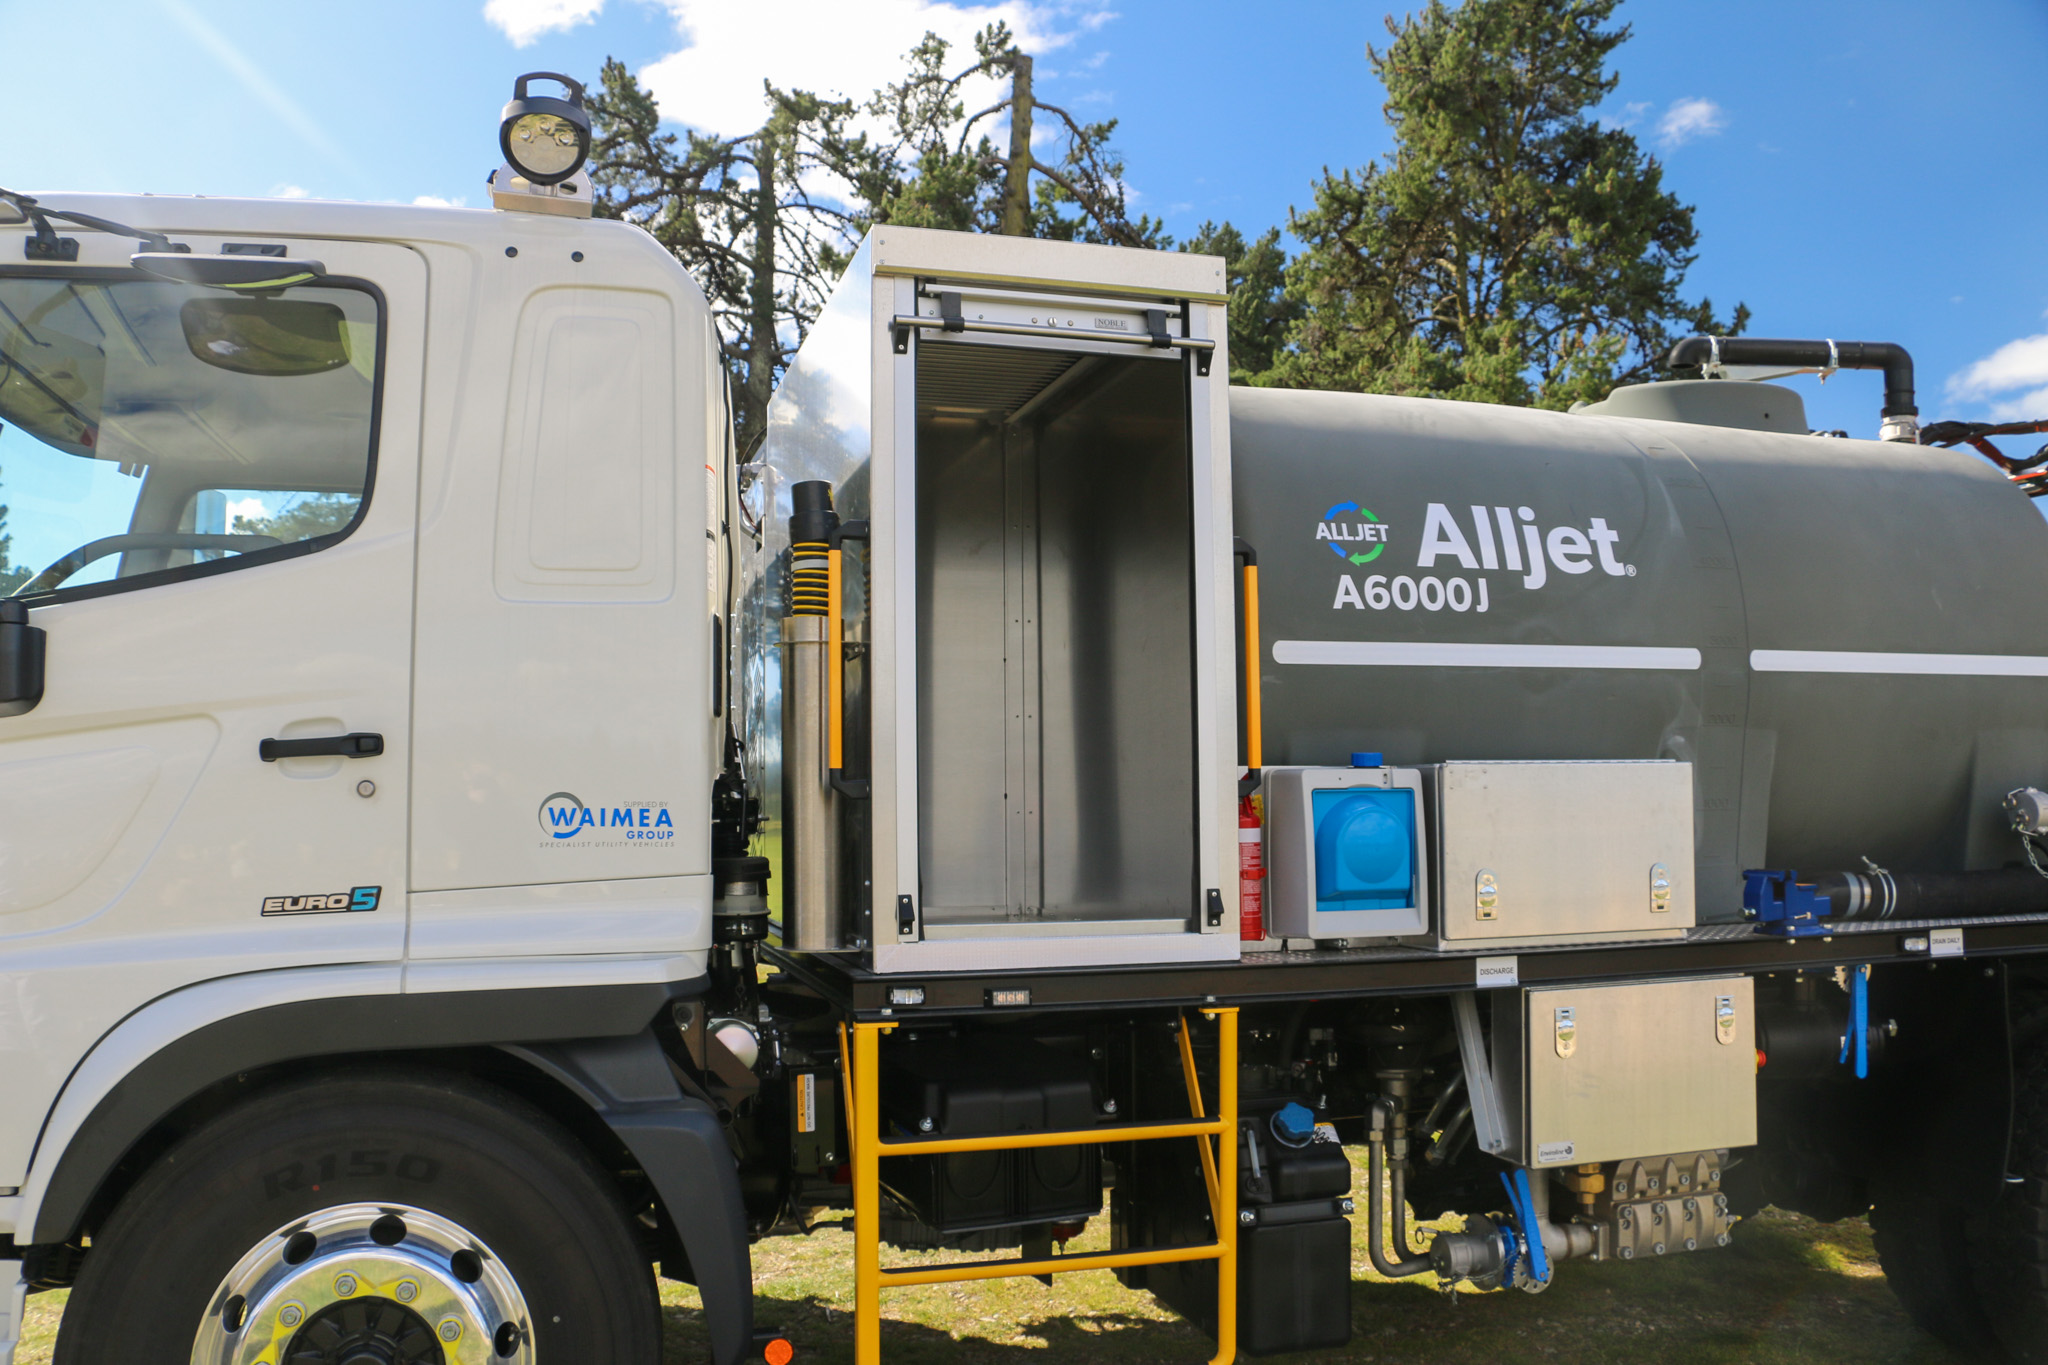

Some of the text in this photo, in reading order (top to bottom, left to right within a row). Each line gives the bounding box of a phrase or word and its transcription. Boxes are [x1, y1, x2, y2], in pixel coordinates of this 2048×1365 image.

[1098, 319, 1126, 327] NOBLE
[1315, 522, 1389, 542] ALLJET
[1333, 574, 1489, 612] A6000J
[547, 807, 673, 827] WAIMEA
[626, 831, 674, 839] GROUP
[1480, 967, 1514, 975] DISCHARGE
